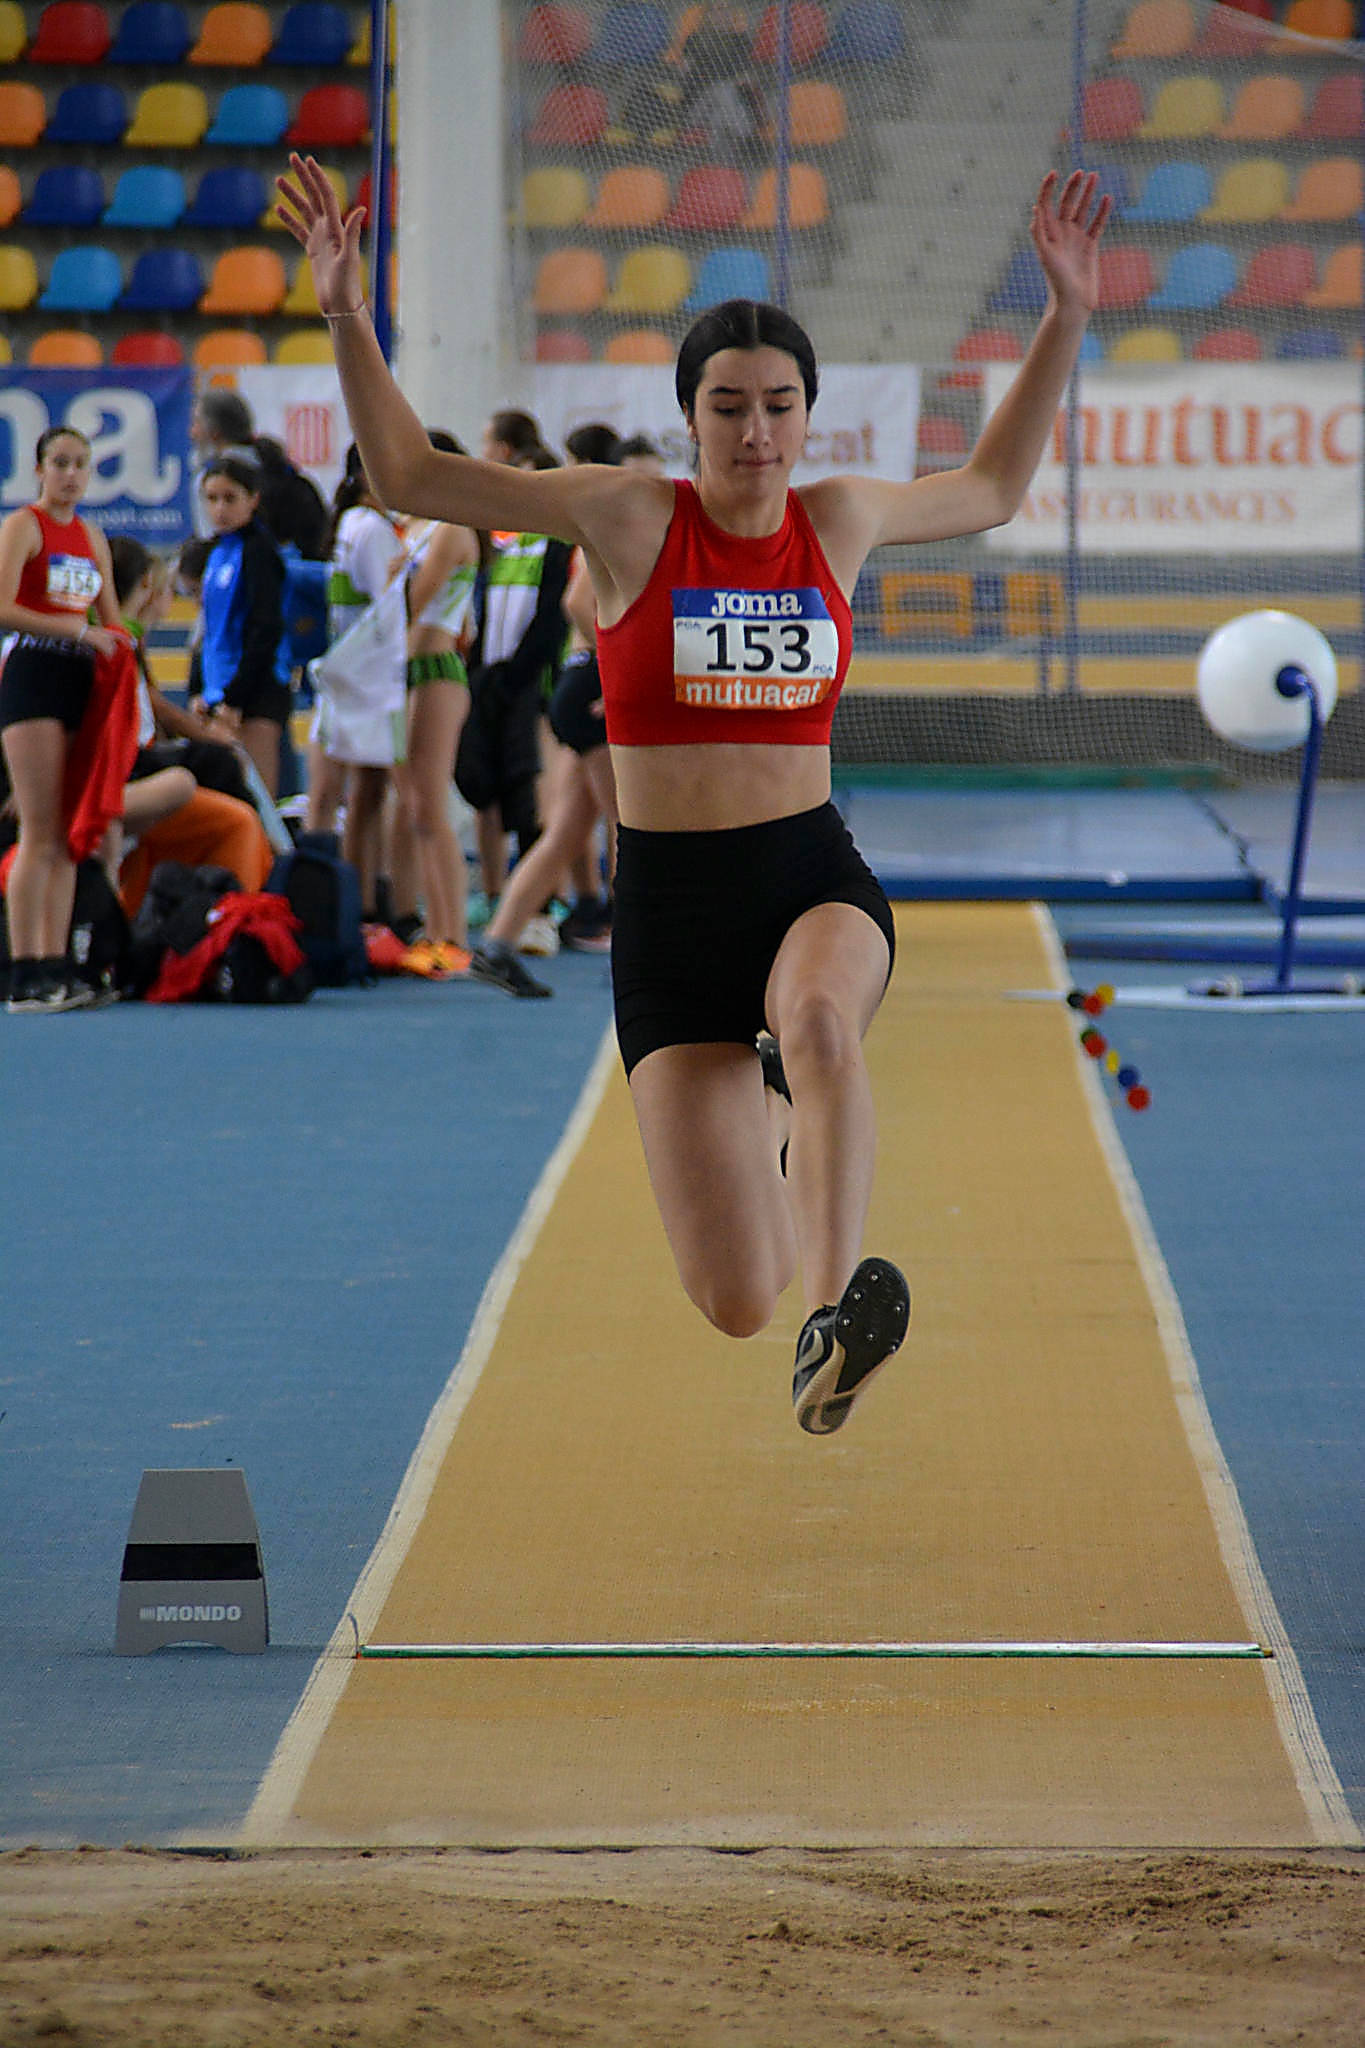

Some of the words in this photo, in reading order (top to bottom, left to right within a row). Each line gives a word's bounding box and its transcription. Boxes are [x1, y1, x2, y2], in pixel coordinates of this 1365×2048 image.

[706, 622, 812, 673] 153
[686, 679, 822, 705] mutuacat
[156, 1605, 242, 1622] MONDO
